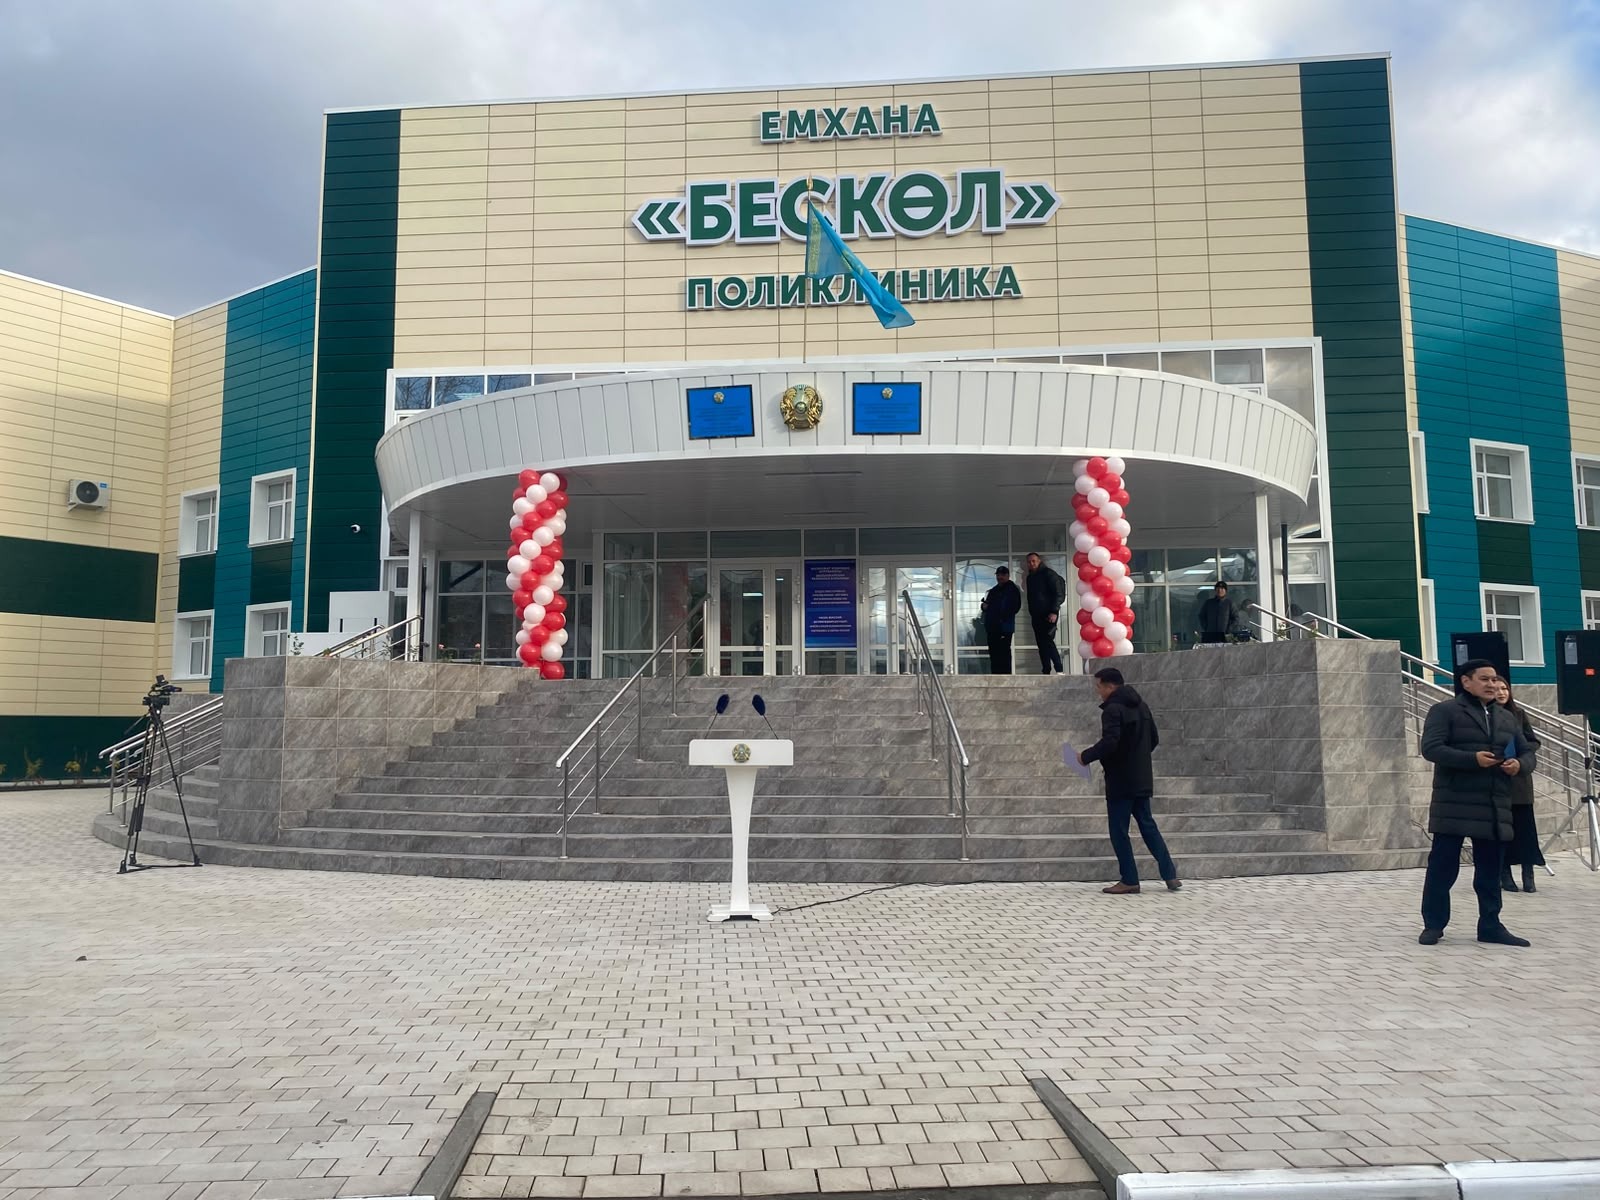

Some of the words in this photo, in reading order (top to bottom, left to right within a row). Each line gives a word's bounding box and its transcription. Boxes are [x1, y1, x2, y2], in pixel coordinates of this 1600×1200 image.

[761, 102, 943, 142] ЕМХАНА
[635, 171, 1059, 243] «БЕСКӨЛ»
[687, 265, 1022, 309] ПОЛИКЛИНИКА
